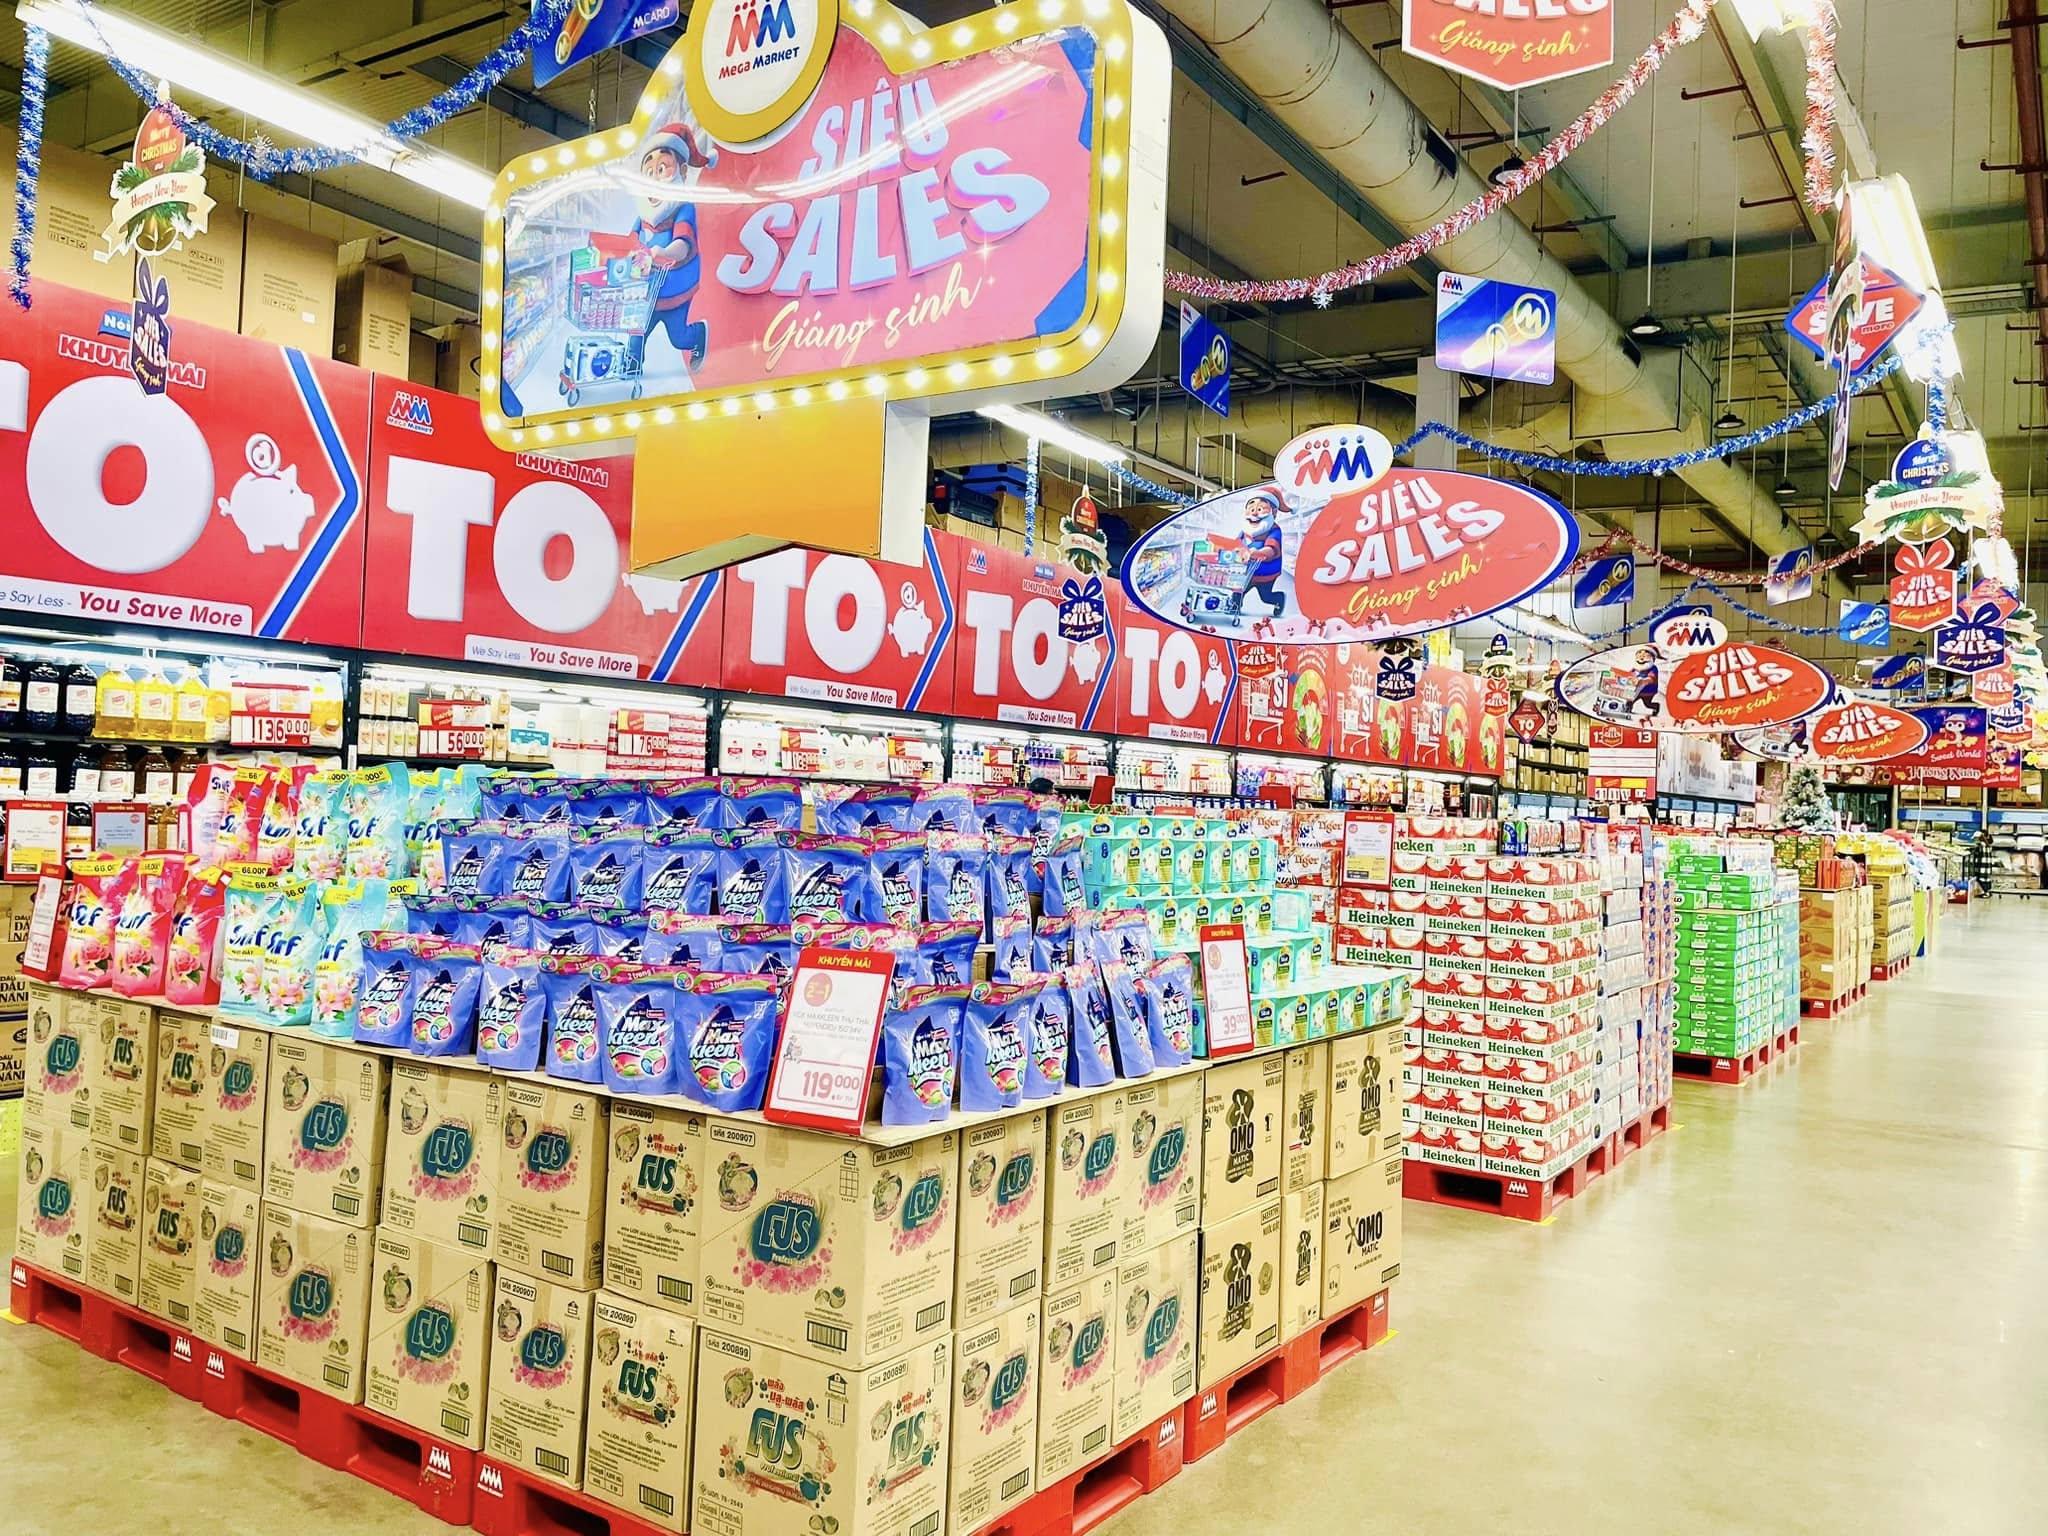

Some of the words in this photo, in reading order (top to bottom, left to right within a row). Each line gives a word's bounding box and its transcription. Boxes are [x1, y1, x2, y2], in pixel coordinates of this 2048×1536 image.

[633, 7, 670, 29] MCARD
[1438, 19, 1515, 65] Giáng
[1521, 30, 1583, 63] sinh
[799, 78, 950, 187] SIÊU
[130, 187, 154, 209] Happy
[153, 181, 171, 199] New
[715, 146, 1052, 298] SALES
[1811, 302, 1829, 312] Yo
[762, 293, 873, 373] Giáng
[884, 264, 985, 348] sinh
[1808, 298, 1895, 335] SVE
[1861, 321, 1895, 334] more
[134, 326, 168, 368] SALES
[1356, 475, 1442, 534] SIÊU
[1889, 495, 1919, 511] Happy
[1920, 492, 1940, 505] New
[1942, 492, 1965, 506] Year
[386, 455, 620, 634] TO
[1312, 500, 1505, 586] SALES
[1347, 580, 1415, 624] Giáng
[1427, 552, 1485, 596] sinh
[1892, 585, 1953, 608] SALES
[10, 590, 34, 608] Say
[38, 593, 65, 608] Less
[79, 590, 119, 615] You
[126, 597, 183, 622] Save
[190, 605, 244, 628] More
[738, 548, 887, 673] TO
[1060, 611, 1103, 626] SALES
[965, 592, 1071, 700] TO
[1938, 638, 2005, 655] SALES
[529, 647, 556, 665] You
[559, 651, 595, 669] Save
[598, 655, 633, 673] More
[1238, 653, 1276, 666] SALES
[1705, 644, 1756, 676] SIÊU
[1125, 626, 1202, 719] TO
[1676, 661, 1794, 702] SALES
[1378, 680, 1415, 690] SALES
[1974, 679, 2014, 693] SALES
[826, 684, 844, 698] You
[846, 687, 868, 702] Save
[870, 690, 894, 705] More
[1698, 699, 1743, 722] Giáng
[1745, 690, 1782, 714] sinh
[1838, 702, 1876, 725] SIÊU
[1027, 710, 1041, 722] You
[1040, 711, 1057, 724] Save
[1057, 713, 1074, 726] More
[1518, 719, 1535, 731] TO
[257, 718, 285, 743] 136
[1637, 731, 1652, 743] 13
[1820, 715, 1903, 744] SALES
[448, 733, 463, 753] 56
[639, 735, 652, 753] 76
[1957, 749, 1982, 760] World
[1257, 816, 1281, 830] Tiger
[1318, 819, 1343, 833] Tiger
[1294, 853, 1320, 868] Tiger
[735, 877, 766, 894] Max
[1429, 880, 1483, 895] Heineken
[1490, 884, 1546, 899] Heineken
[1347, 909, 1415, 929] Heineken
[1428, 917, 1482, 932] Heineken
[1489, 923, 1546, 938] Heineken
[1345, 947, 1413, 966] Heineken
[1429, 956, 1482, 971] Heineken
[1489, 963, 1546, 978] Heineken
[1427, 995, 1480, 1011] Heineken
[1488, 1001, 1545, 1018] Heineken
[623, 1015, 665, 1033] Max
[606, 1027, 660, 1046] kleen
[706, 1028, 742, 1045] Max
[1427, 1032, 1481, 1050] Heineken
[689, 1043, 736, 1060] kleen
[1487, 1041, 1544, 1058] Heineken
[802, 1069, 834, 1099] 119
[834, 1074, 861, 1090] 000
[1426, 1071, 1481, 1089] Heineken
[1487, 1080, 1544, 1097] Heineken
[518, 1090, 544, 1104] 200907
[1360, 1083, 1381, 1112] OMO
[1074, 1107, 1093, 1120] 200907
[1424, 1110, 1478, 1128] Heineken
[726, 1130, 754, 1144] 200907
[982, 1128, 1005, 1143] 200907
[1486, 1119, 1544, 1137] Heineken
[1229, 1121, 1254, 1155] OMO
[1232, 1153, 1250, 1166] MATIC
[1422, 1148, 1476, 1167] Heineken
[1485, 1159, 1541, 1178] Heineken
[1356, 1210, 1384, 1248] OMO
[1360, 1241, 1380, 1255] MATIC
[512, 1283, 536, 1298] 200907
[1227, 1274, 1252, 1312] OMO
[610, 1309, 635, 1324] 200899
[977, 1331, 999, 1347] 200907
[721, 1340, 750, 1358] 200899
[882, 1363, 907, 1382] 200899
